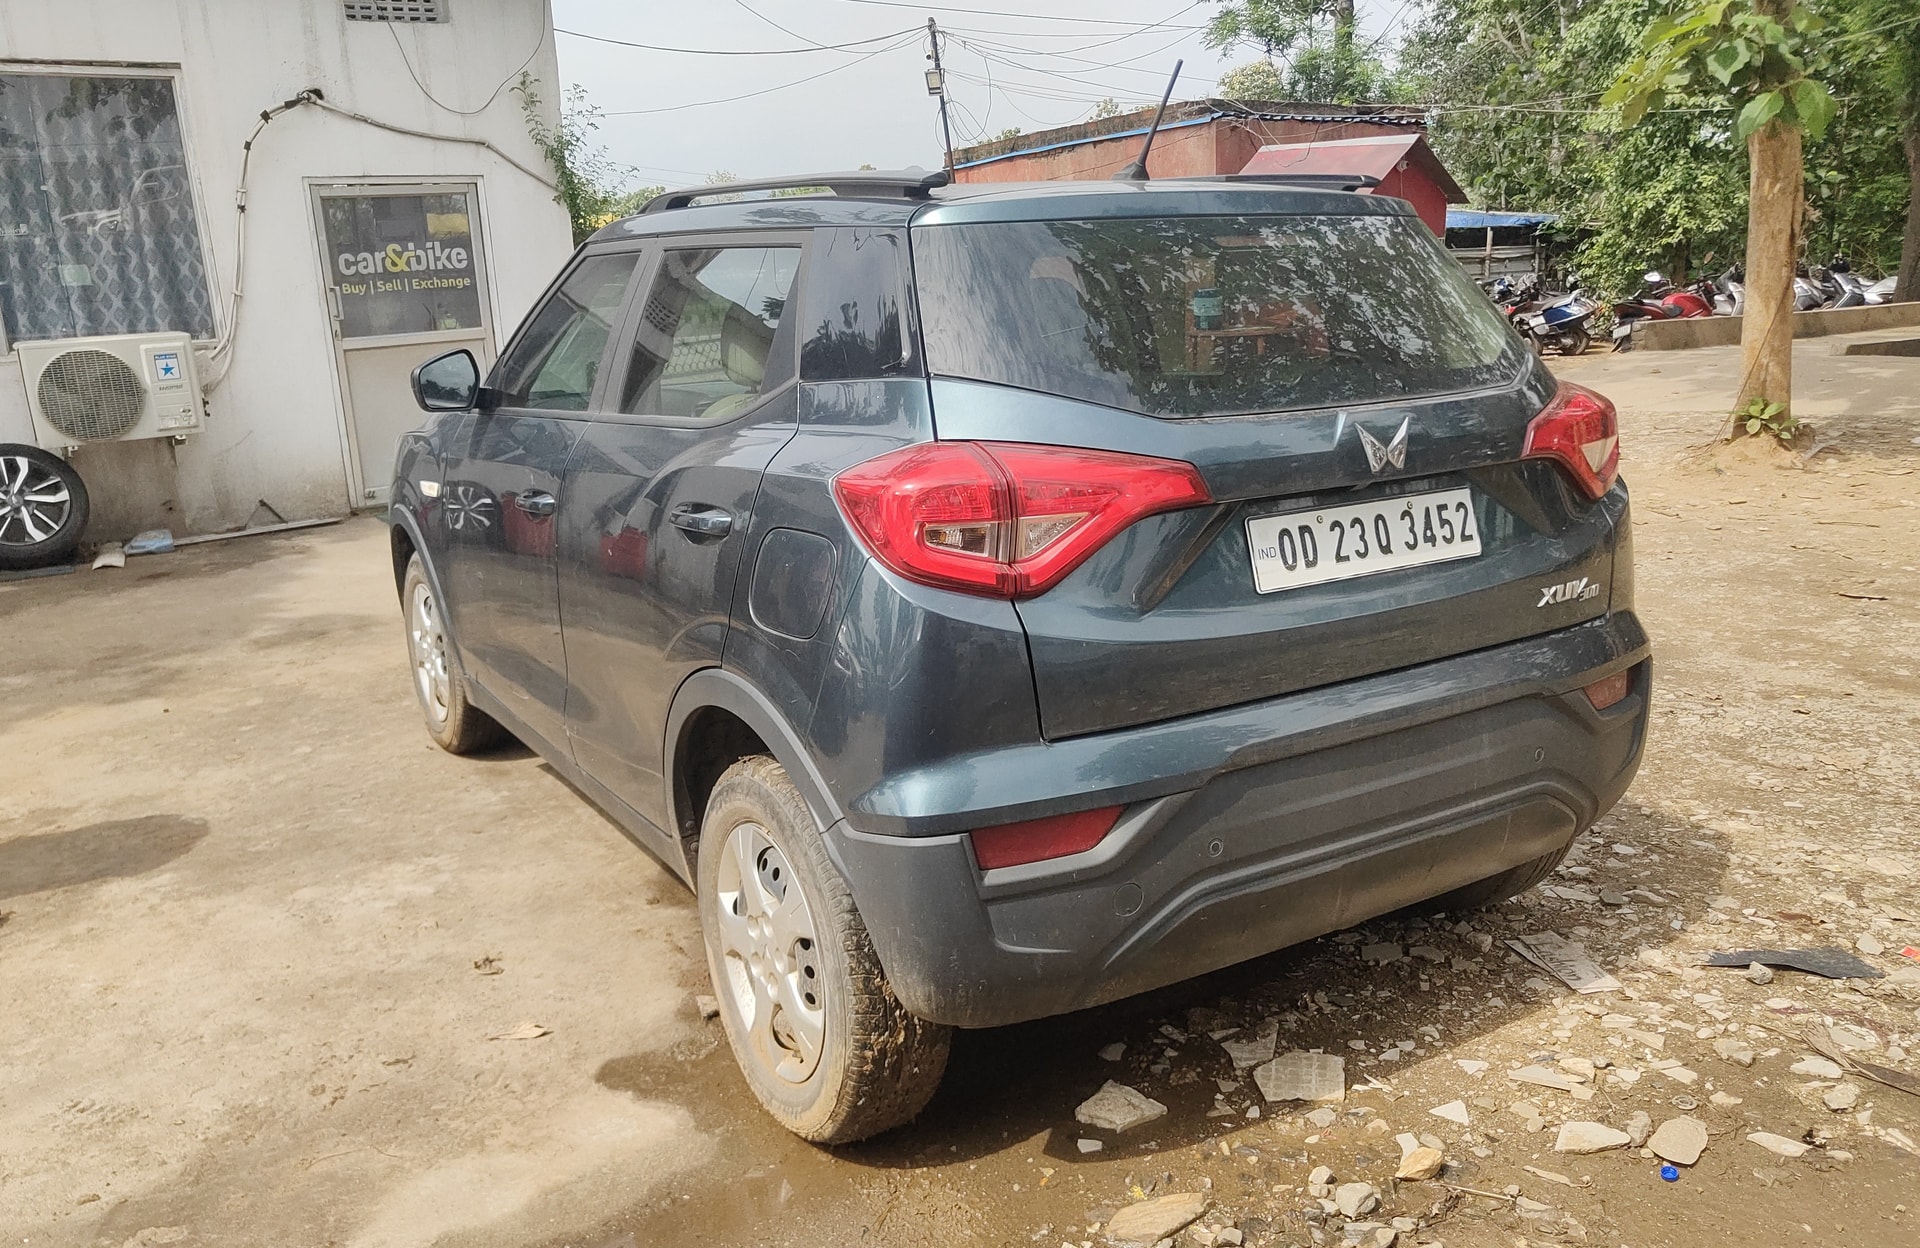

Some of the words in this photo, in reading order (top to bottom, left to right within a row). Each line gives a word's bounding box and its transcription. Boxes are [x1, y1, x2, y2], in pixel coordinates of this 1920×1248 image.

[338, 241, 468, 276] car&bike
[342, 283, 367, 295] Buy
[377, 279, 402, 292] Sell
[412, 277, 471, 290] Exchange
[1257, 546, 1276, 560] IND
[1278, 525, 1318, 571] OD
[1400, 502, 1474, 551] 3452
